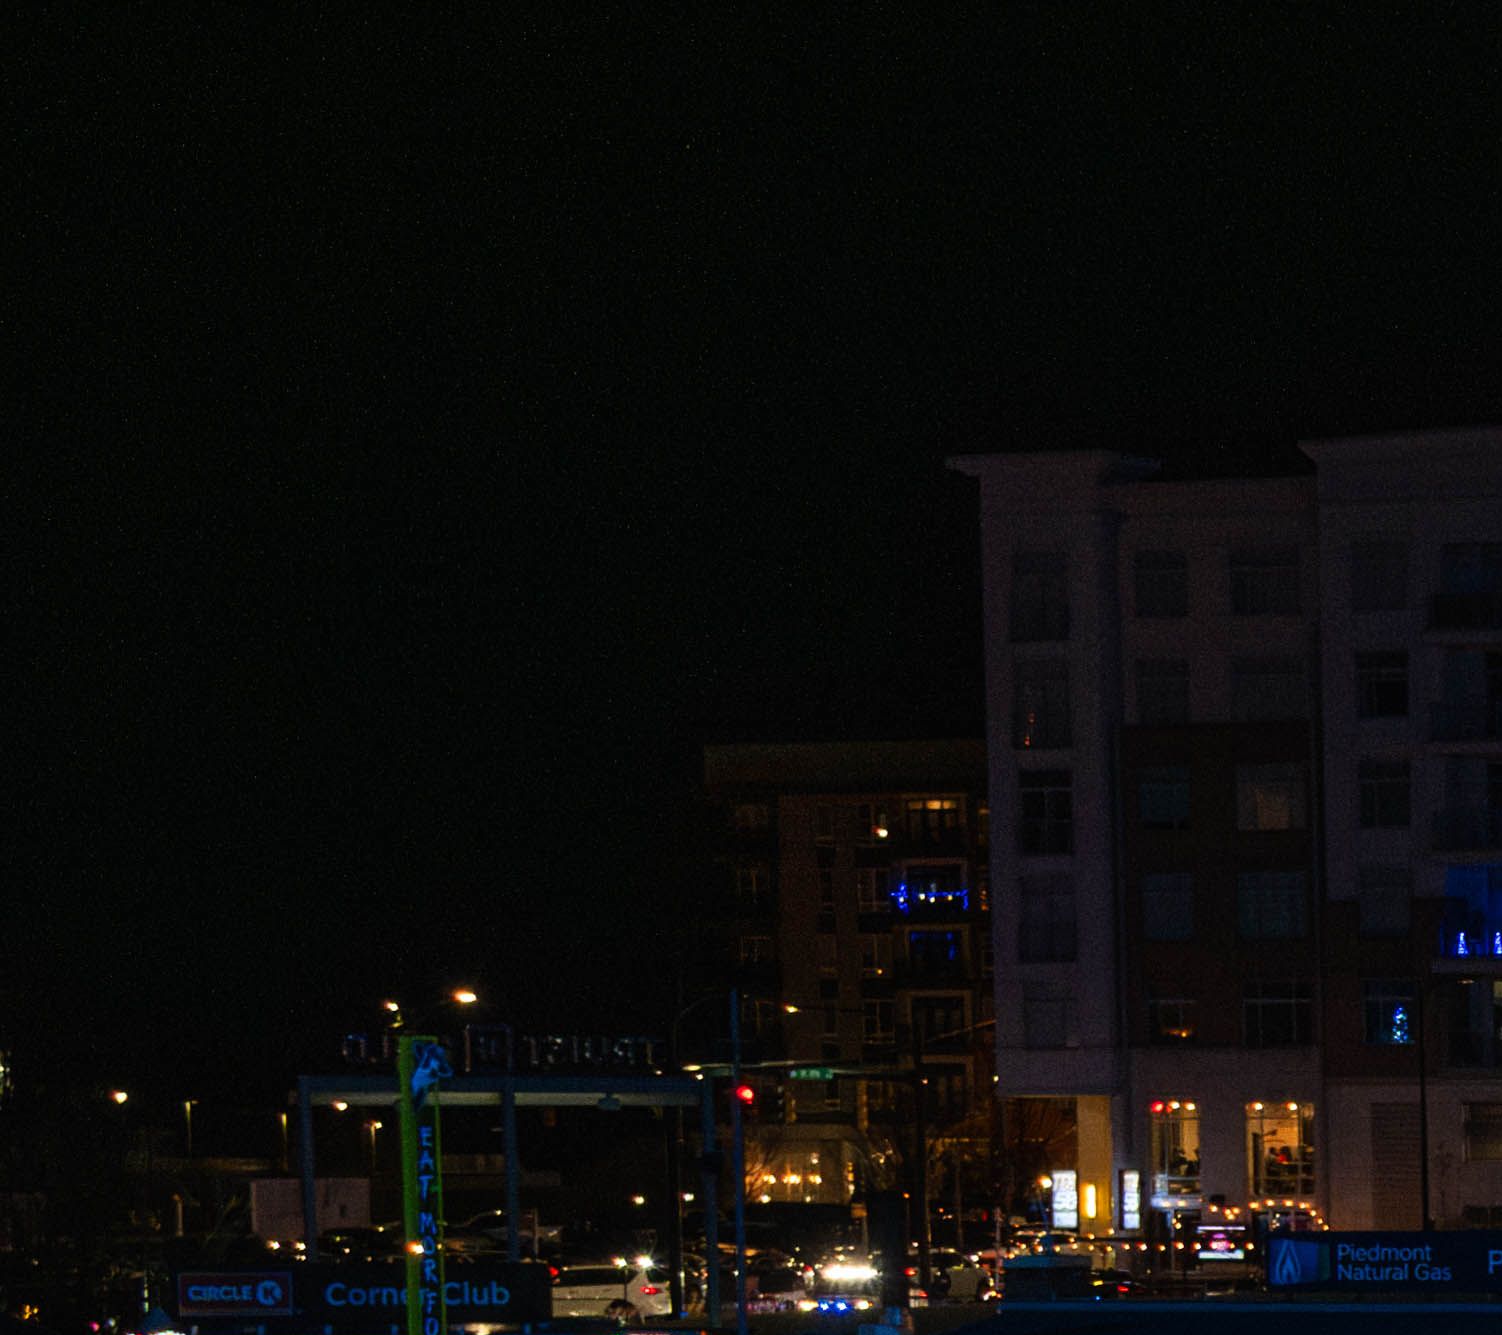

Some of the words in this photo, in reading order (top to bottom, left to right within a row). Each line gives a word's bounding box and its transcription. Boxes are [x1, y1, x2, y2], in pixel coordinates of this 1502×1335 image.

[417, 1124, 434, 1201] EAT
[1336, 1244, 1433, 1263] Piedmont
[1336, 1263, 1408, 1281] Natural
[1411, 1263, 1453, 1282] Gas
[442, 1280, 512, 1306] Club
